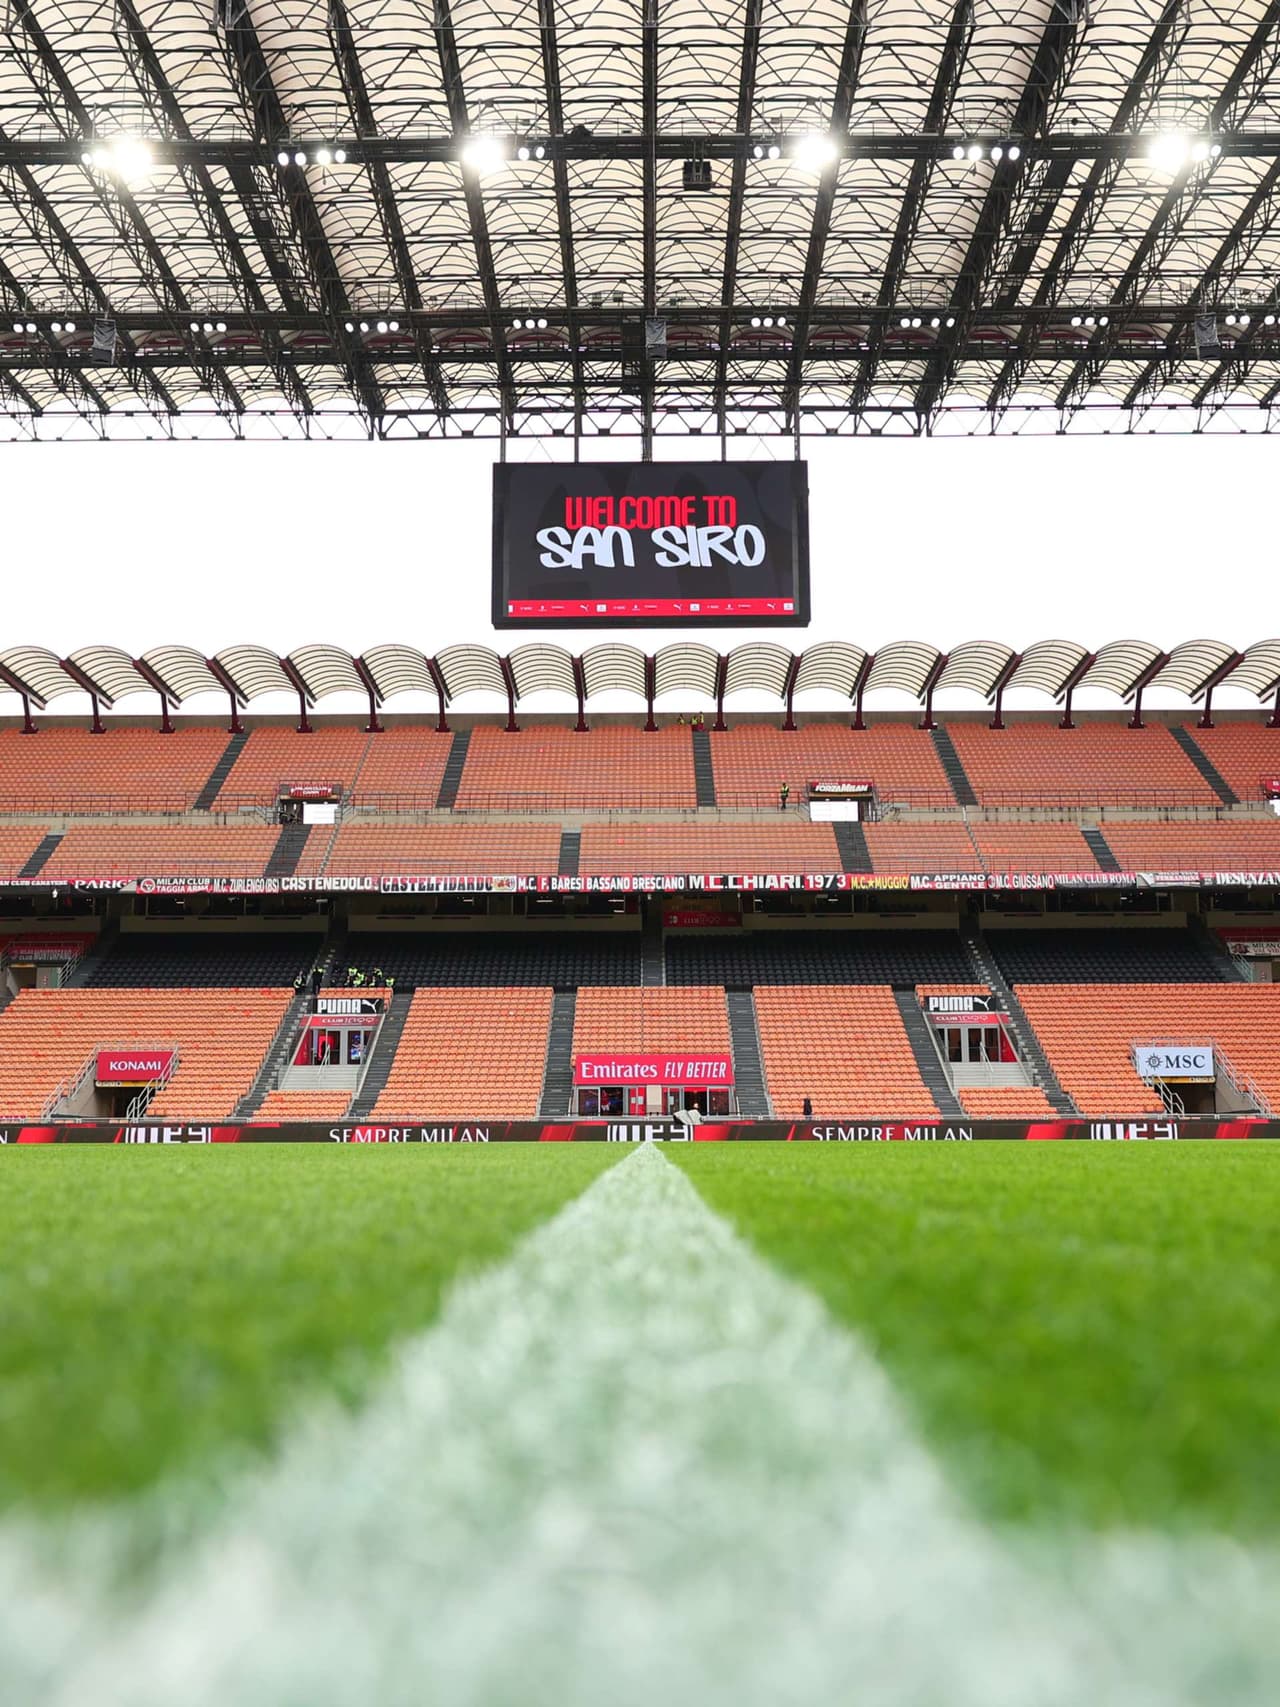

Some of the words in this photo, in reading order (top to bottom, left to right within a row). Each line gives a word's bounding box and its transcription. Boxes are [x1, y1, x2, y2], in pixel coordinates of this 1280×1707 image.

[565, 496, 695, 529] WELCOME
[702, 496, 736, 528] TO
[536, 525, 635, 569] SAN
[650, 524, 766, 568] SIRO
[382, 878, 493, 892] CASTELFIDARDO
[551, 878, 584, 890] BARESI
[587, 877, 630, 890] BASSANO
[632, 877, 684, 890] BRESCIANO
[933, 874, 986, 882] APPIANO
[1012, 875, 1054, 888] GIUSSANO
[1055, 874, 1083, 884] MILAN
[1085, 874, 1109, 884] CLUB
[157, 885, 185, 893] TAGGIA
[317, 999, 361, 1013] PUMA
[929, 997, 973, 1011] PUMA
[109, 1061, 161, 1071] KONAMI
[1165, 1055, 1206, 1069] MSC
[581, 1062, 658, 1078] Emirates
[664, 1062, 684, 1078] FLY
[686, 1062, 726, 1078] BETTER
[329, 1128, 413, 1142] SEMPRE
[421, 1128, 489, 1142] MILAN
[812, 1127, 896, 1141] SEMPRE
[904, 1127, 973, 1141] MILAN
